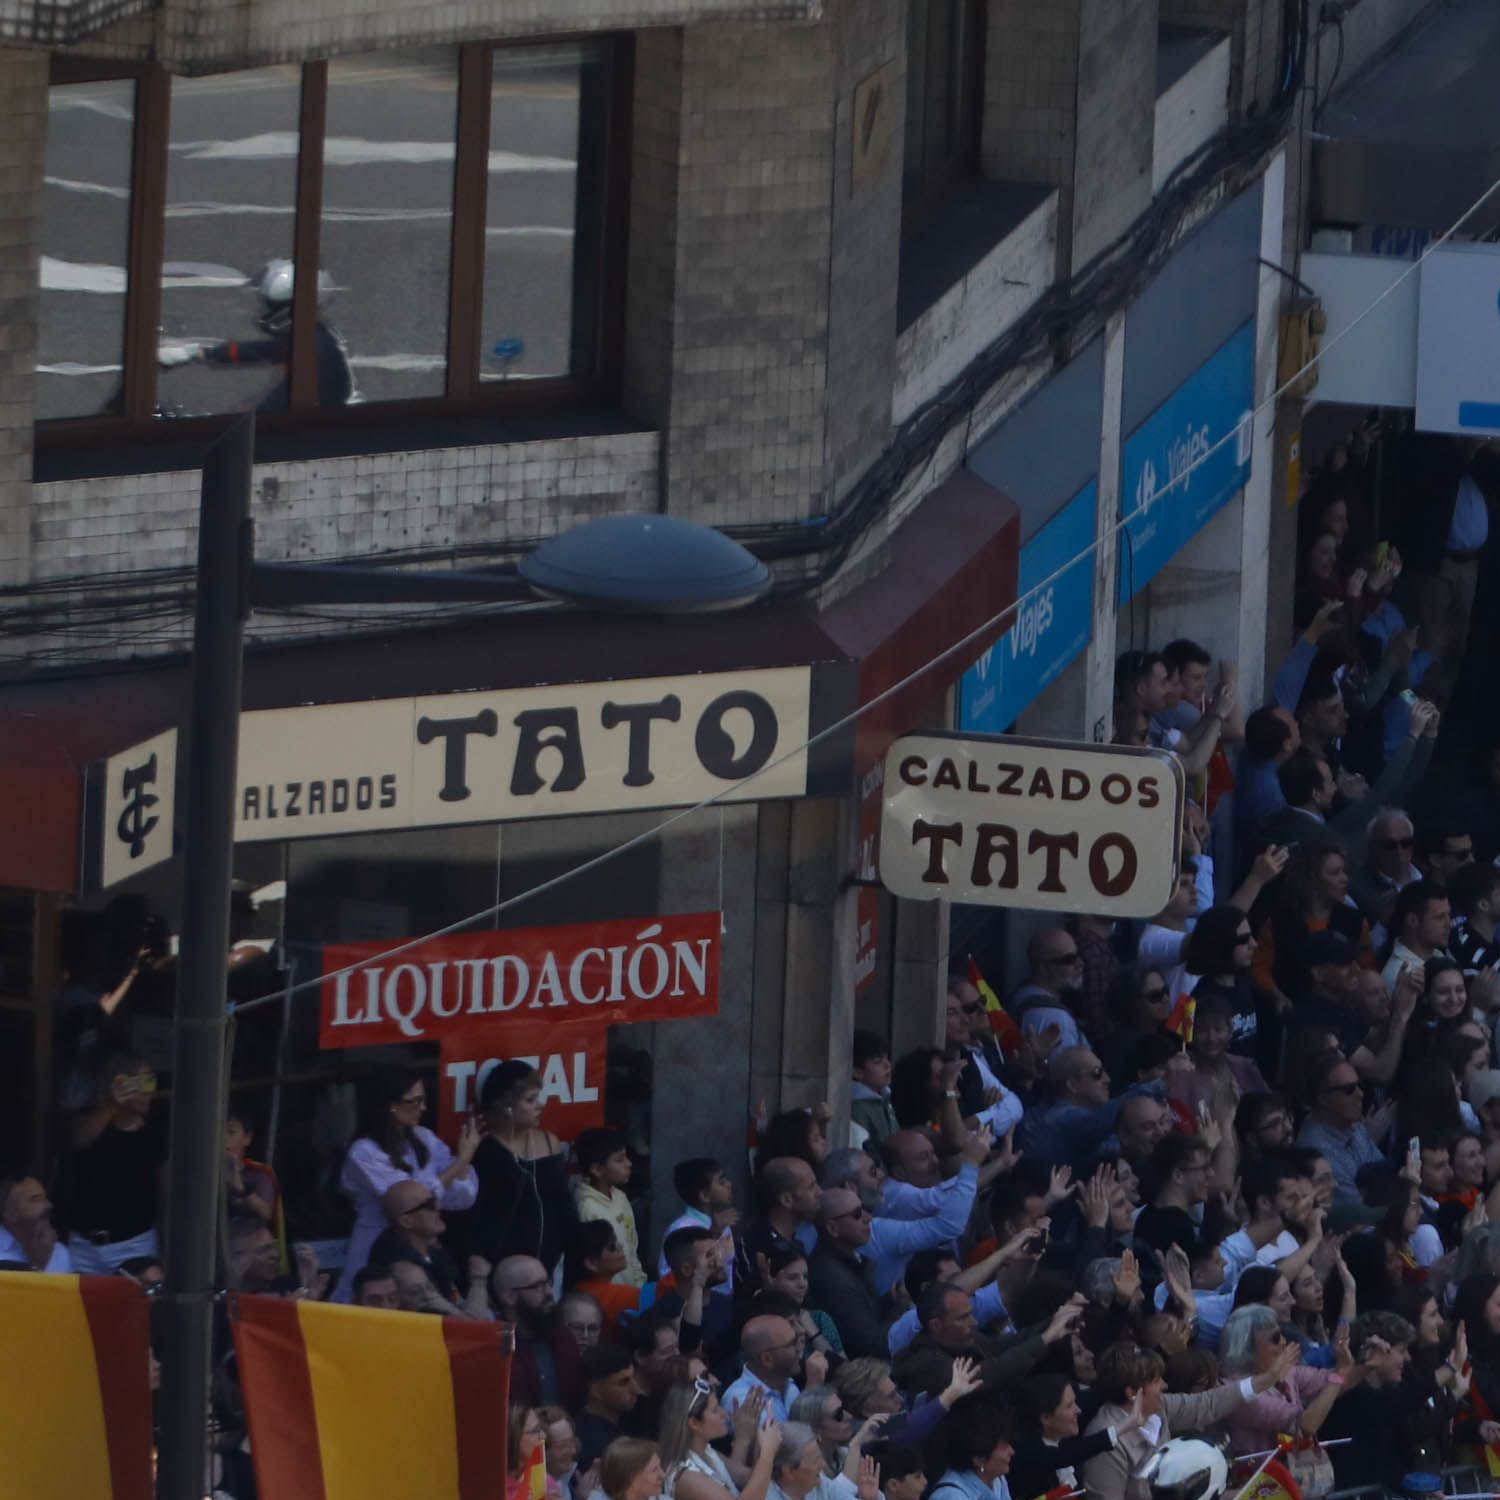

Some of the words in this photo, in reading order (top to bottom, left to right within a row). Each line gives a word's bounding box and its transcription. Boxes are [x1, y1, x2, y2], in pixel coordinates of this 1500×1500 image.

[1167, 423, 1210, 494] Viajes
[1009, 586, 1055, 661] Viajes
[243, 773, 397, 821] ALZADOS
[417, 689, 778, 802] TATO
[899, 755, 1160, 808] CALZADOS
[911, 818, 1138, 897] TATO
[330, 923, 712, 1037] LIQUIDACIÓN
